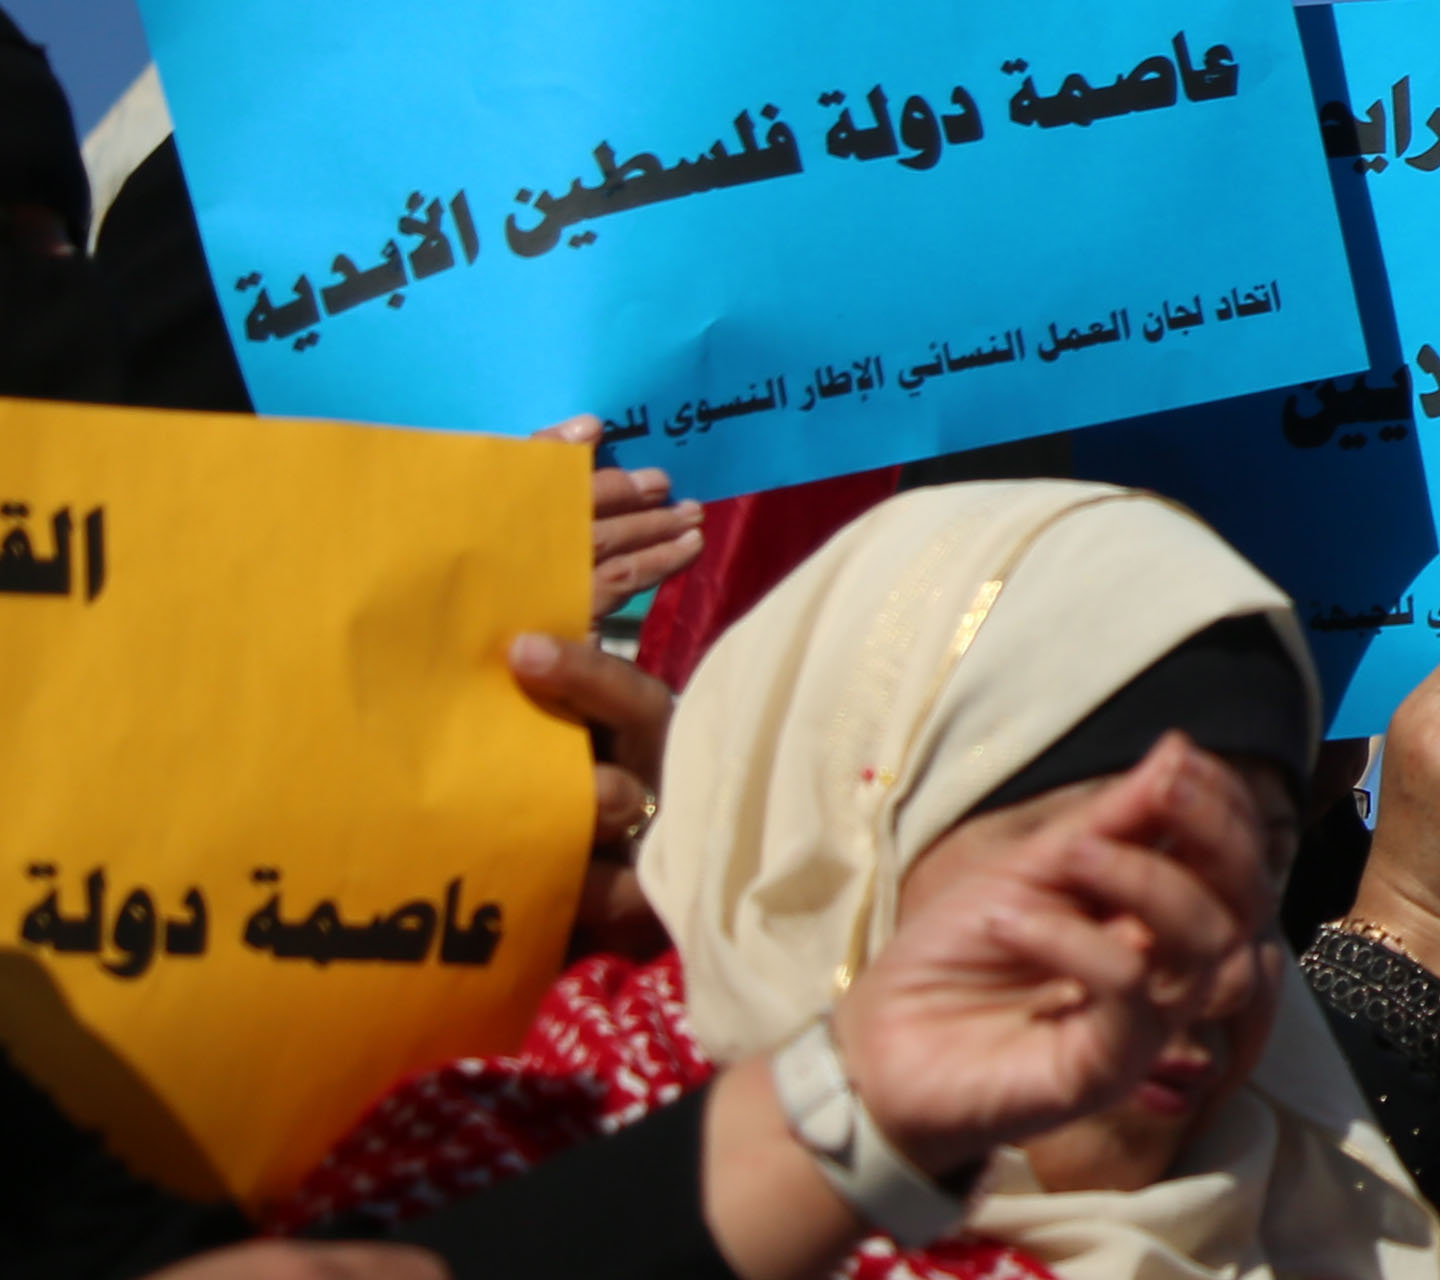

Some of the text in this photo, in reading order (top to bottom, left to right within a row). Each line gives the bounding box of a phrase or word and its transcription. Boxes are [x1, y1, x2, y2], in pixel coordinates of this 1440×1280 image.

[234, 31, 1240, 354] عاصمة دولة فلسطين الأبدية
[1142, 296, 1204, 343] لجان
[1215, 281, 1282, 322] اتحاد
[897, 329, 1025, 399] النسائي
[1037, 308, 1131, 363] العمل
[663, 378, 788, 448] النسوي
[797, 356, 884, 414] الإطار
[19, 860, 504, 980] عاصمة دولة
